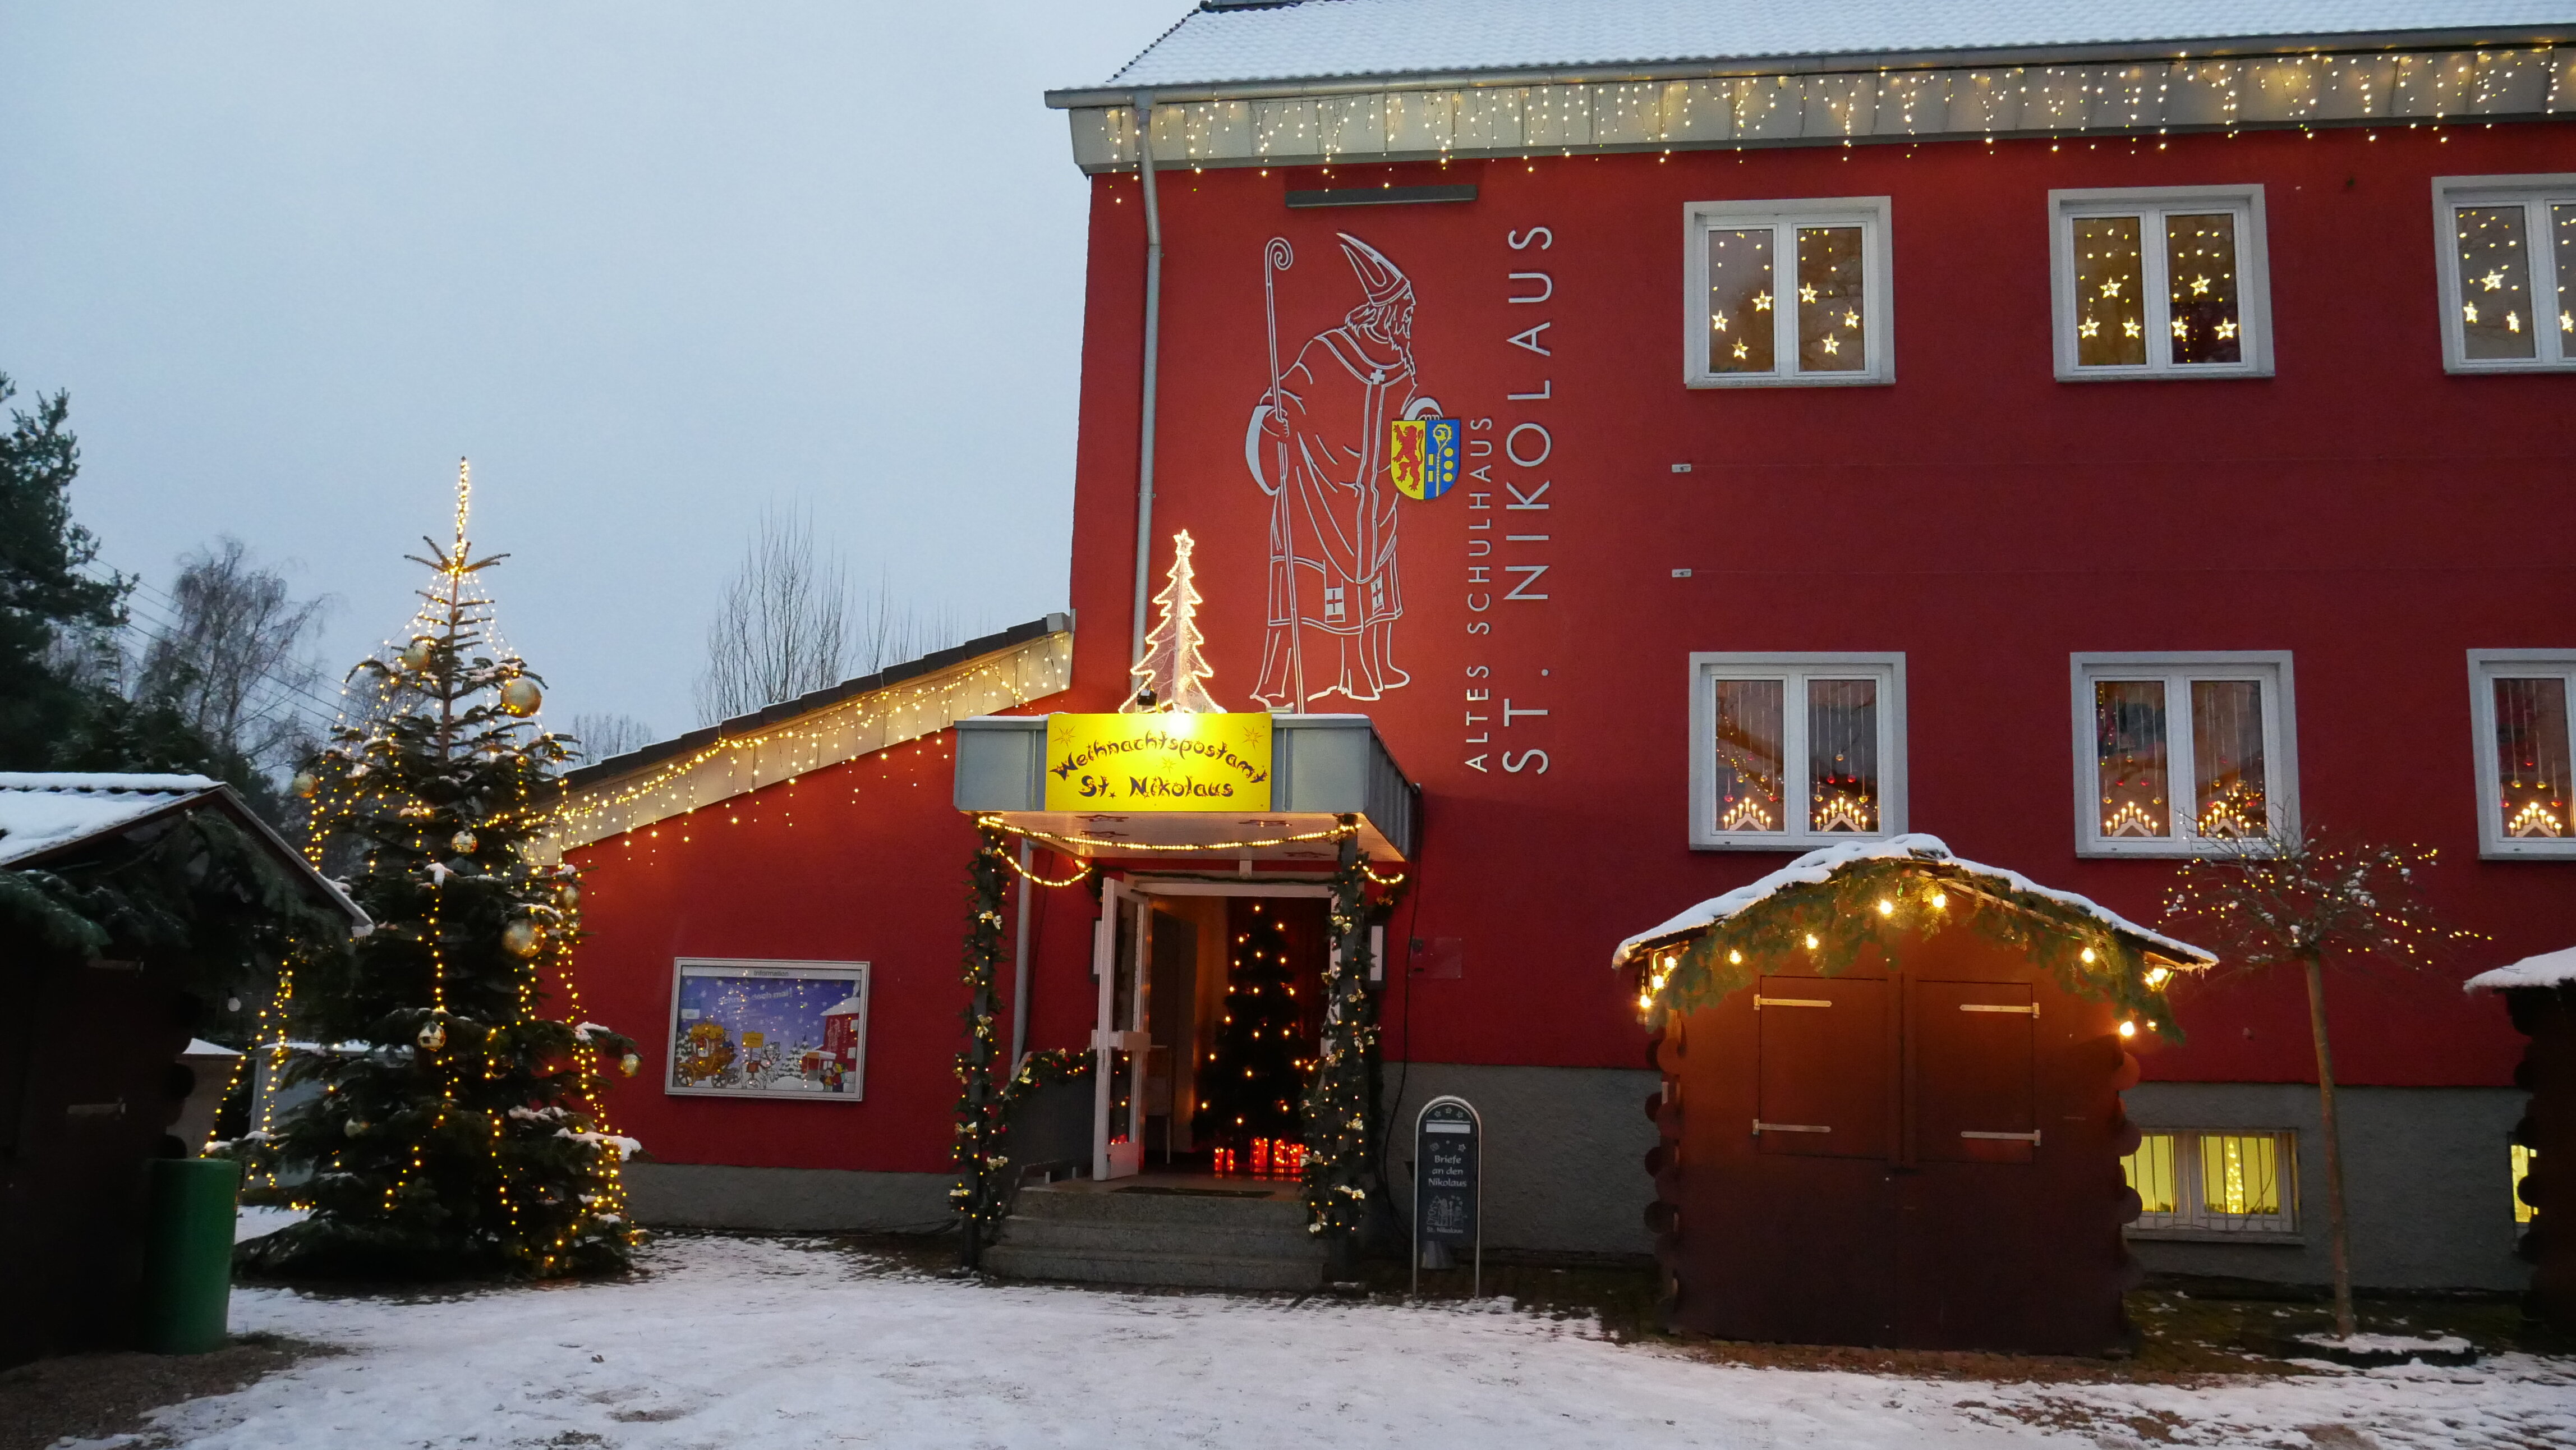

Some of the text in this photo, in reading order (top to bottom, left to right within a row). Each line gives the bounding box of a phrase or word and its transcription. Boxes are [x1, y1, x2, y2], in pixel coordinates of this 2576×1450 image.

[1502, 226, 1552, 774] ST. NIKOLAUS
[1465, 417, 1492, 773] ALTES SCHULHAUS
[1049, 729, 1268, 783] Weihnachtspostamt
[1078, 775, 1234, 799] St. Nikolaus
[1434, 1155, 1461, 1164] Briefe
[1446, 1167, 1463, 1175] den
[1428, 1178, 1467, 1187] Nikolaus
